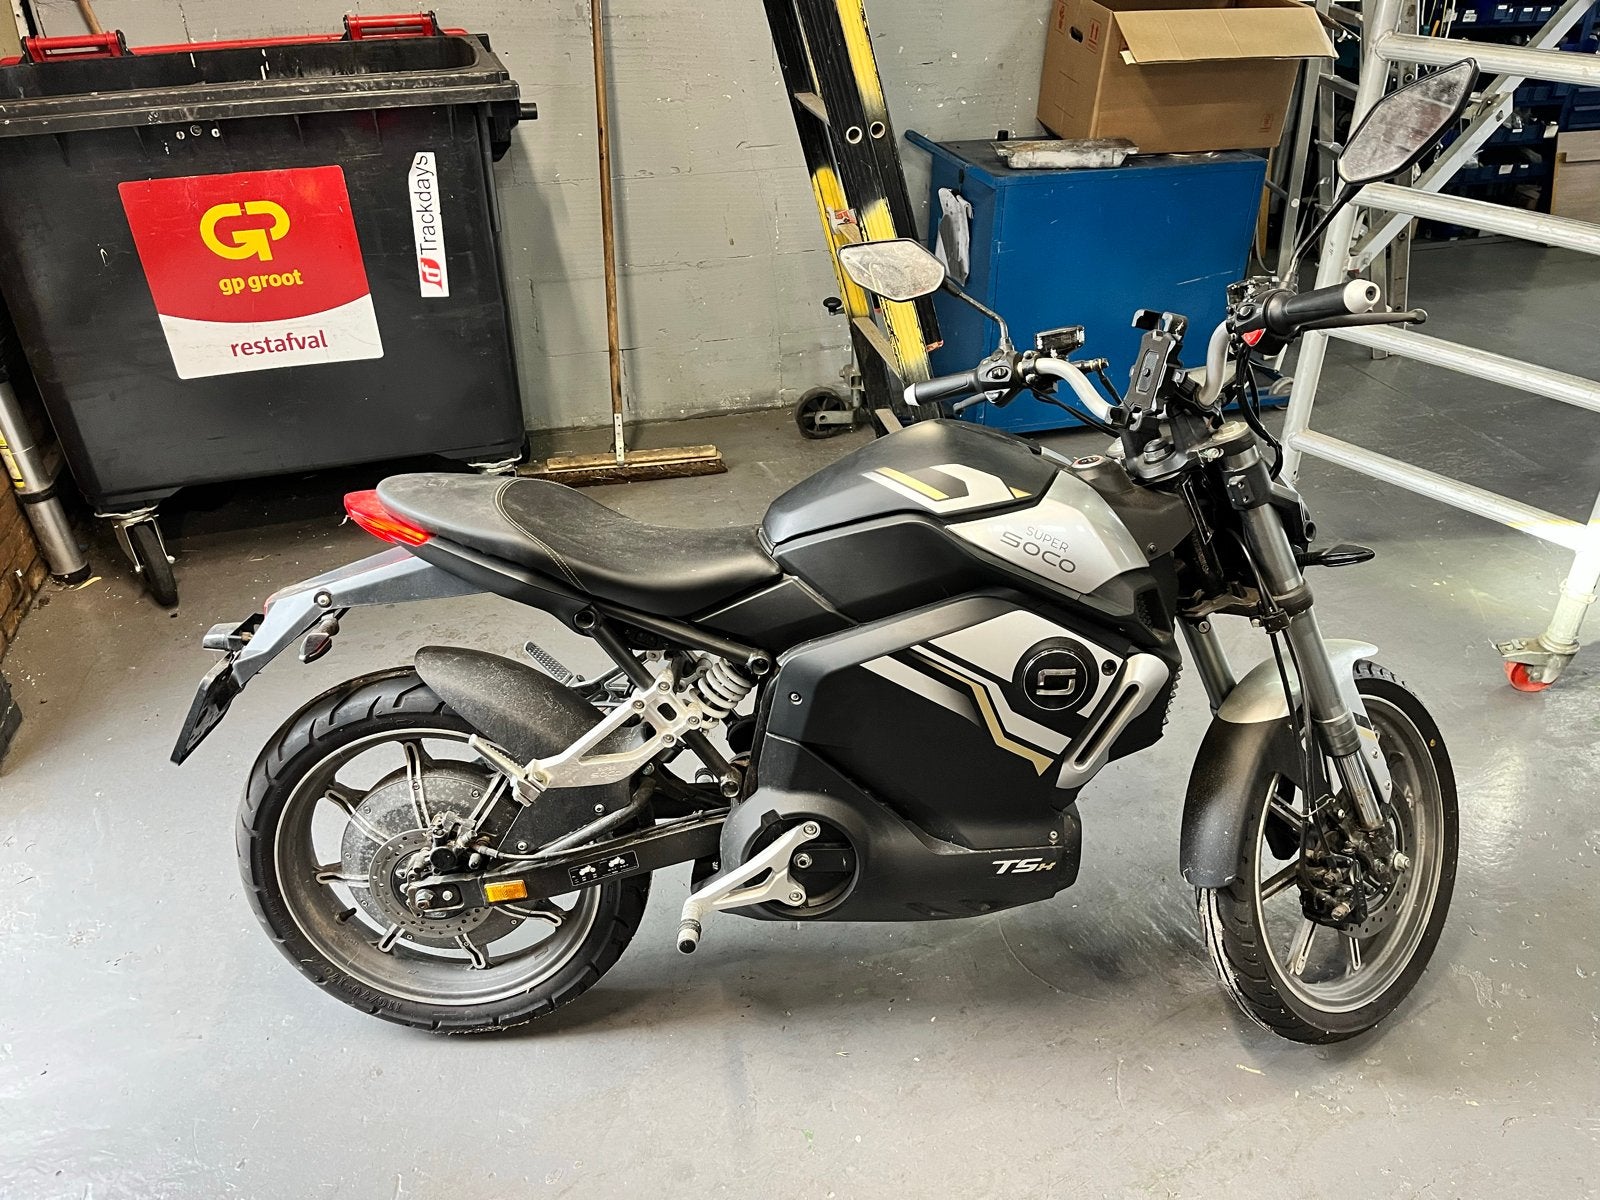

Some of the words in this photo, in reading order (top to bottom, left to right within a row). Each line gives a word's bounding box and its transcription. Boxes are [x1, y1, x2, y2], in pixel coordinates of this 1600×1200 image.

[414, 155, 437, 255] Trackdays
[218, 277, 246, 296] gp
[247, 269, 304, 293] groot
[230, 329, 329, 357] restafval
[1000, 531, 1076, 573] SOCO
[1026, 526, 1069, 553] SUPER
